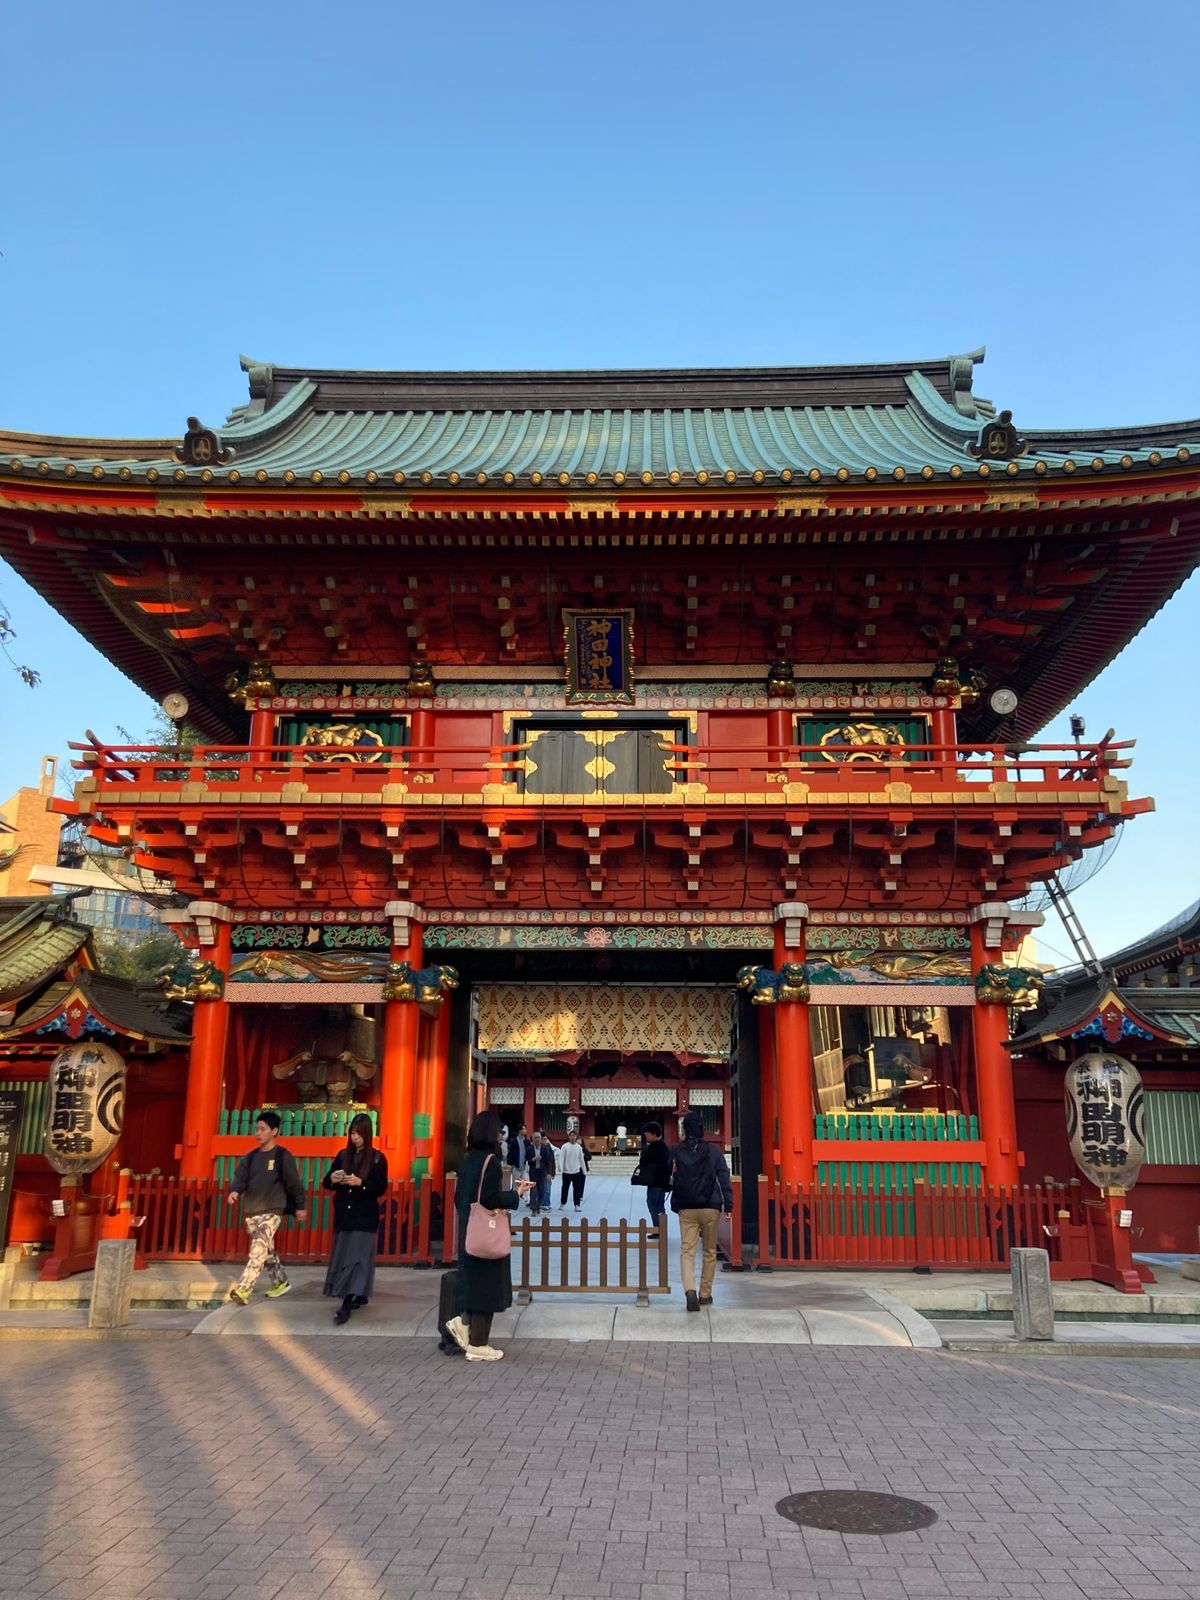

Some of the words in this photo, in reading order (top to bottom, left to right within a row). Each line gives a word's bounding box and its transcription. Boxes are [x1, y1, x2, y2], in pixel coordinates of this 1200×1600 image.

[586, 619, 613, 690] 神田神社
[51, 1064, 95, 1154] 神田明神
[1077, 1075, 1129, 1167] 神田明神
